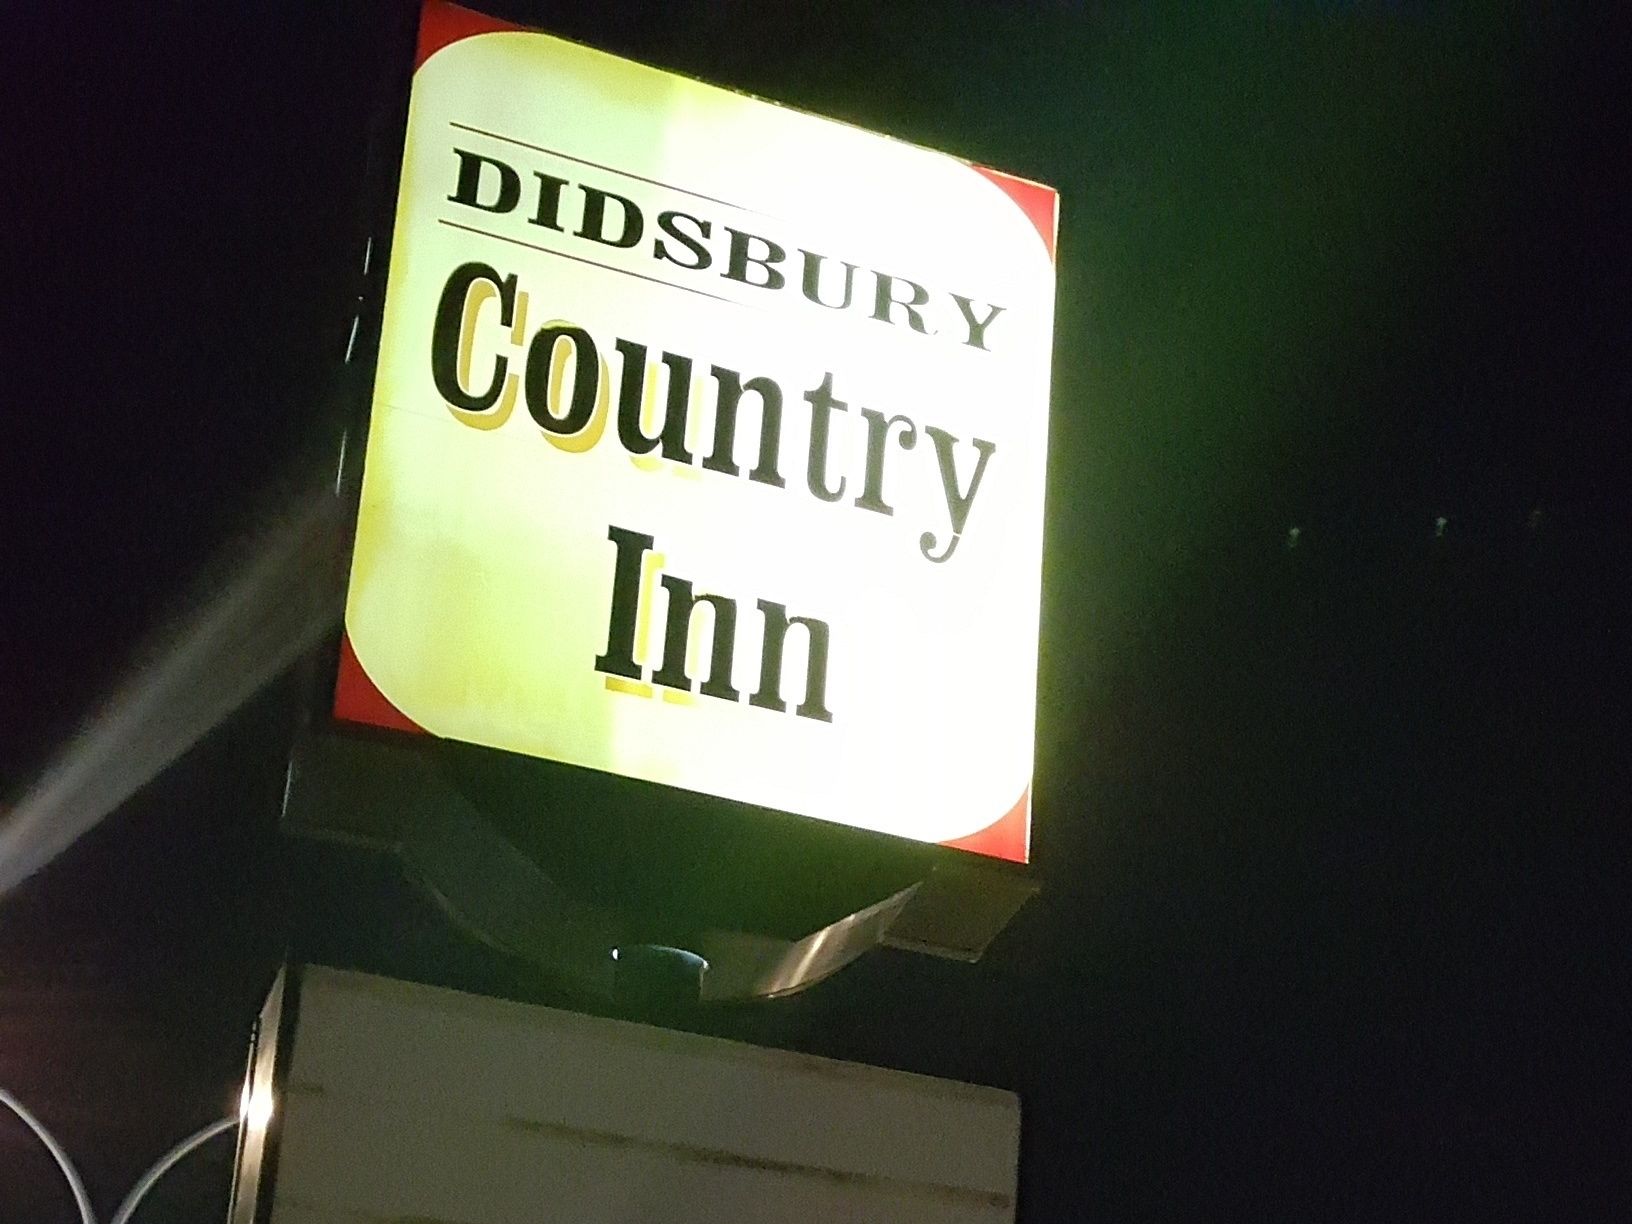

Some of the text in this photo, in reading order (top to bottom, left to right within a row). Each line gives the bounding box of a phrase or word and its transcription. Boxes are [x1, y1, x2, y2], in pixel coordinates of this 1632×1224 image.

[447, 146, 1007, 352] DIDSBURY
[431, 260, 997, 564] Country
[594, 523, 834, 724] Inn
